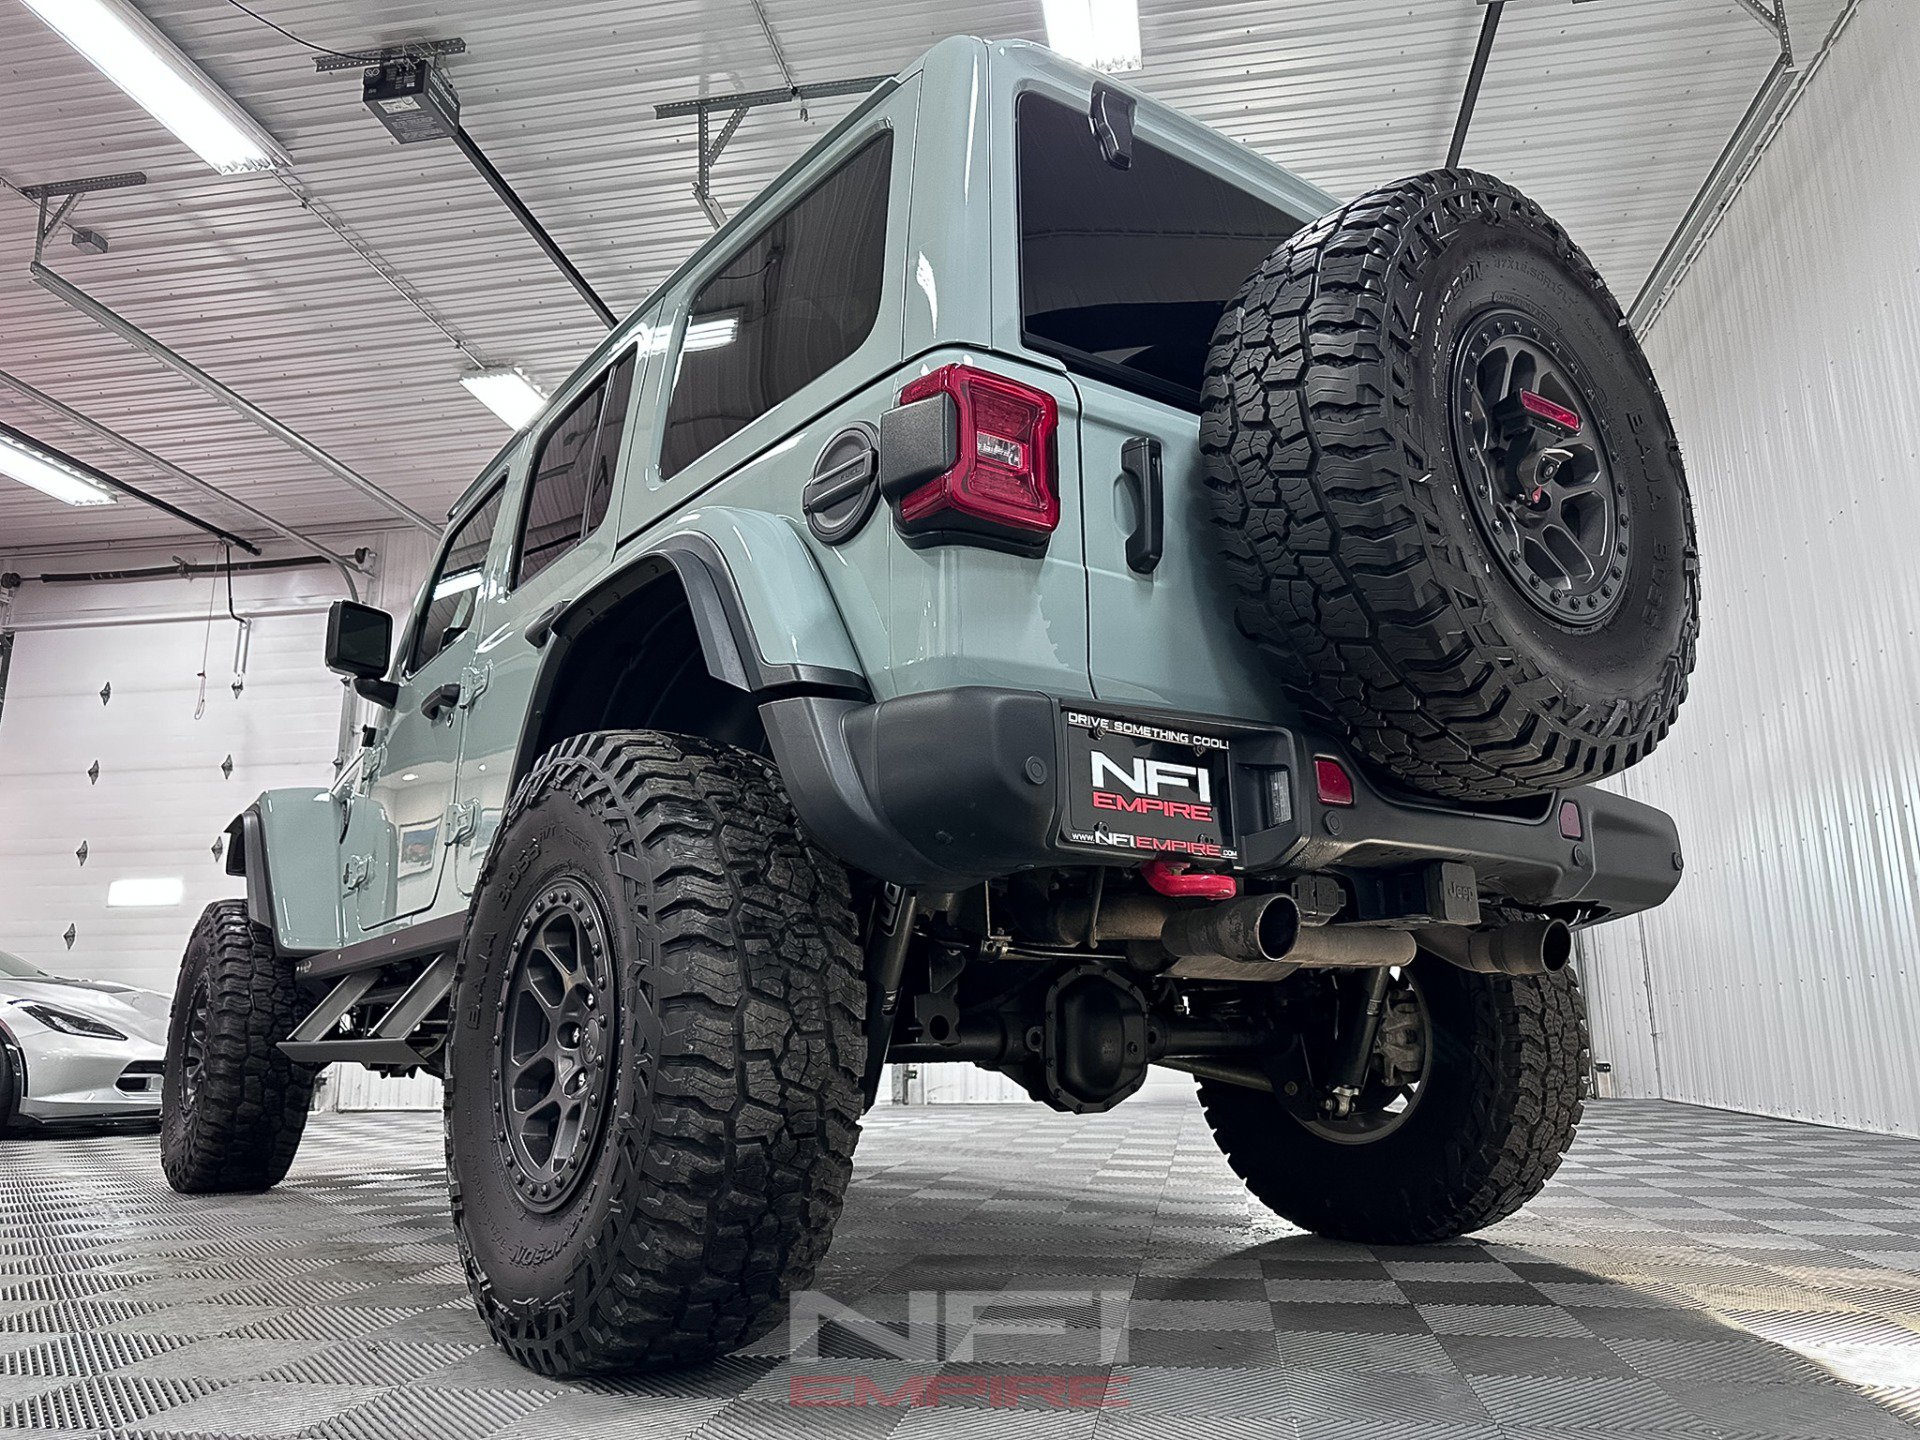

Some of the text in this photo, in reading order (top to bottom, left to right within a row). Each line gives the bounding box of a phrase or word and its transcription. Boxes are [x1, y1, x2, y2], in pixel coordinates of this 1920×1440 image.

[841, 466, 862, 480] FUEL
[1068, 711, 1230, 750] DRIVE SOMETHING COOL!
[1090, 750, 1211, 803] NFI
[1092, 791, 1213, 822] EMPIRE
[498, 838, 541, 912] BOSS
[1448, 881, 1475, 902] Jeep
